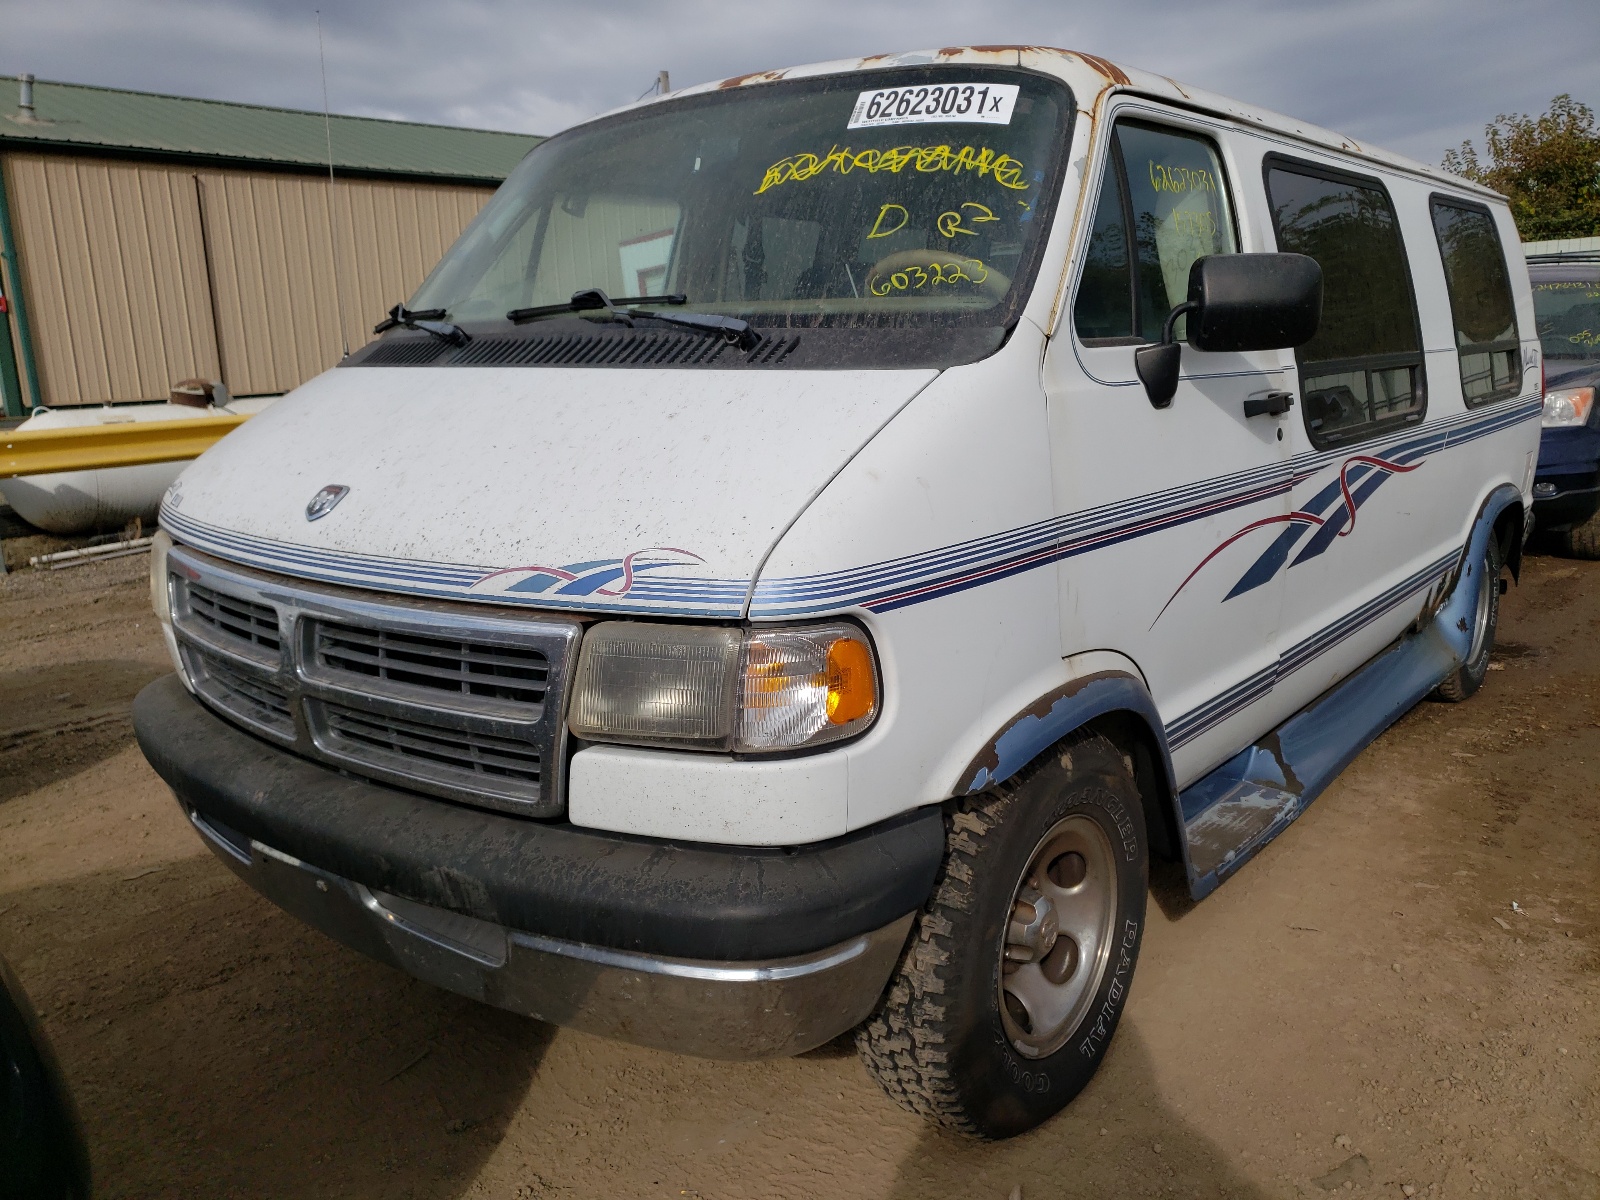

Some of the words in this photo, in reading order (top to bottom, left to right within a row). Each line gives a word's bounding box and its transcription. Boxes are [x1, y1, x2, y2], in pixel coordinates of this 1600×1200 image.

[866, 85, 990, 119] 62623031
[866, 203, 909, 239] D
[870, 259, 988, 297] 603223
[1079, 919, 1138, 1058] RADIAL
